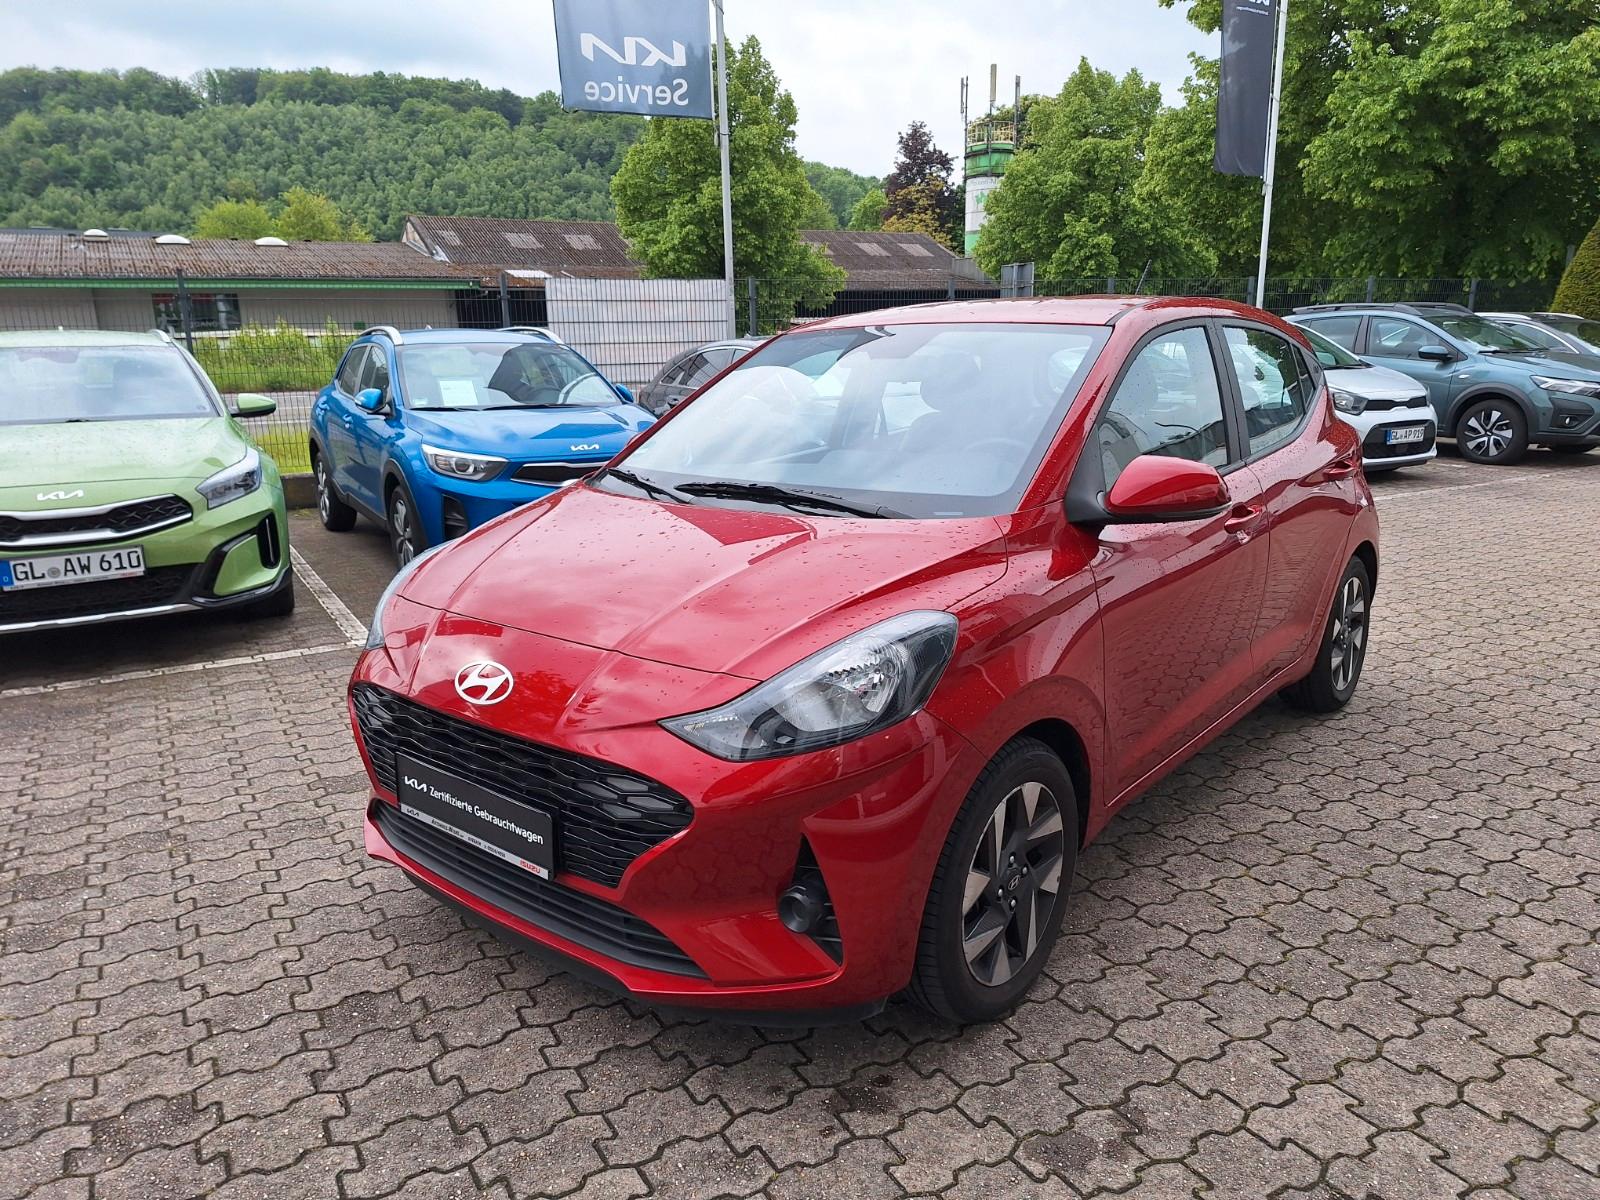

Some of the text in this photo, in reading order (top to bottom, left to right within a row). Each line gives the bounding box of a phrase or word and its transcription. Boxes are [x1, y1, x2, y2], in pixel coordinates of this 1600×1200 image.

[12, 562, 45, 582] GL
[64, 555, 91, 577] AW
[100, 550, 141, 572] 610
[404, 775, 428, 793] KIA
[429, 785, 473, 814] Zertifizierte
[474, 805, 544, 845] Gebrauchtwagen
